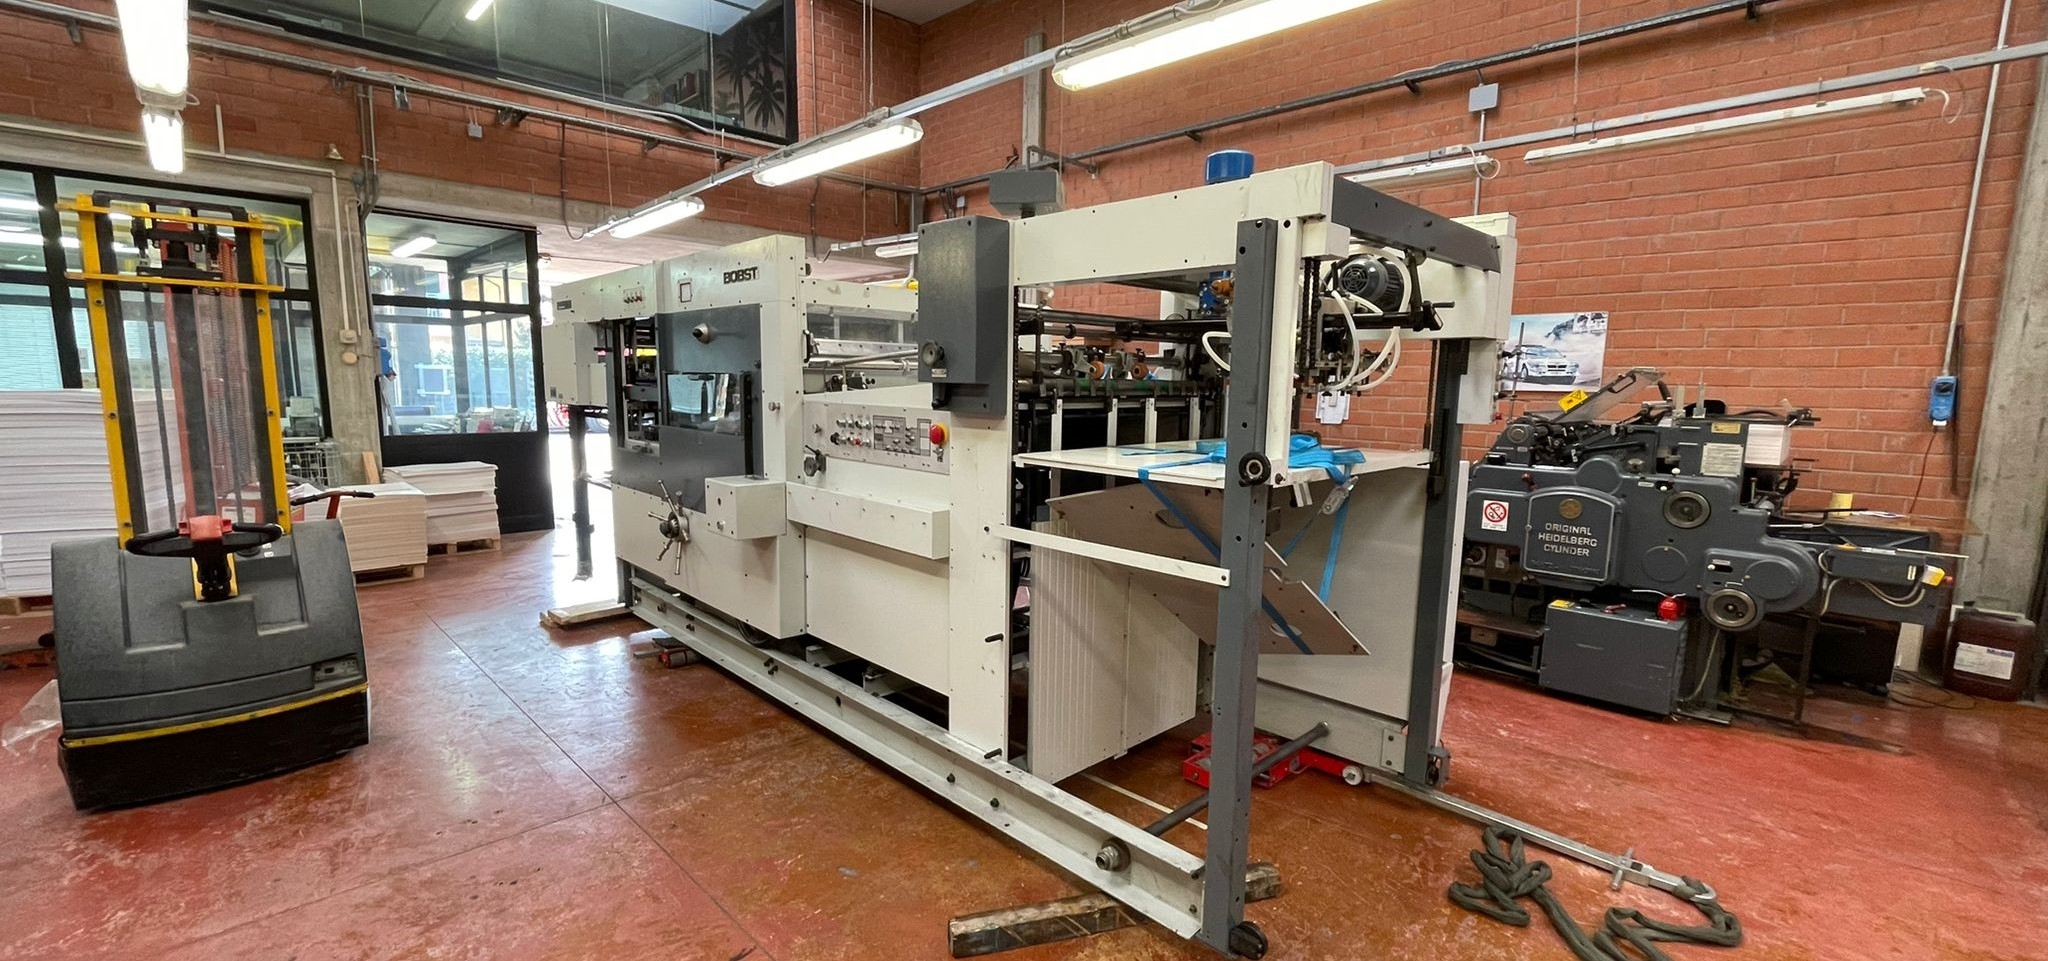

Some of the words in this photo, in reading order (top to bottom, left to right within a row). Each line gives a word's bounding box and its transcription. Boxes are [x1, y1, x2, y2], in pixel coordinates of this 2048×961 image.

[723, 266, 758, 284] BOBST
[1545, 522, 1592, 536] ORIGINAL
[1538, 532, 1598, 547] HEIDELBERG
[1543, 543, 1590, 557] CYLINDER
